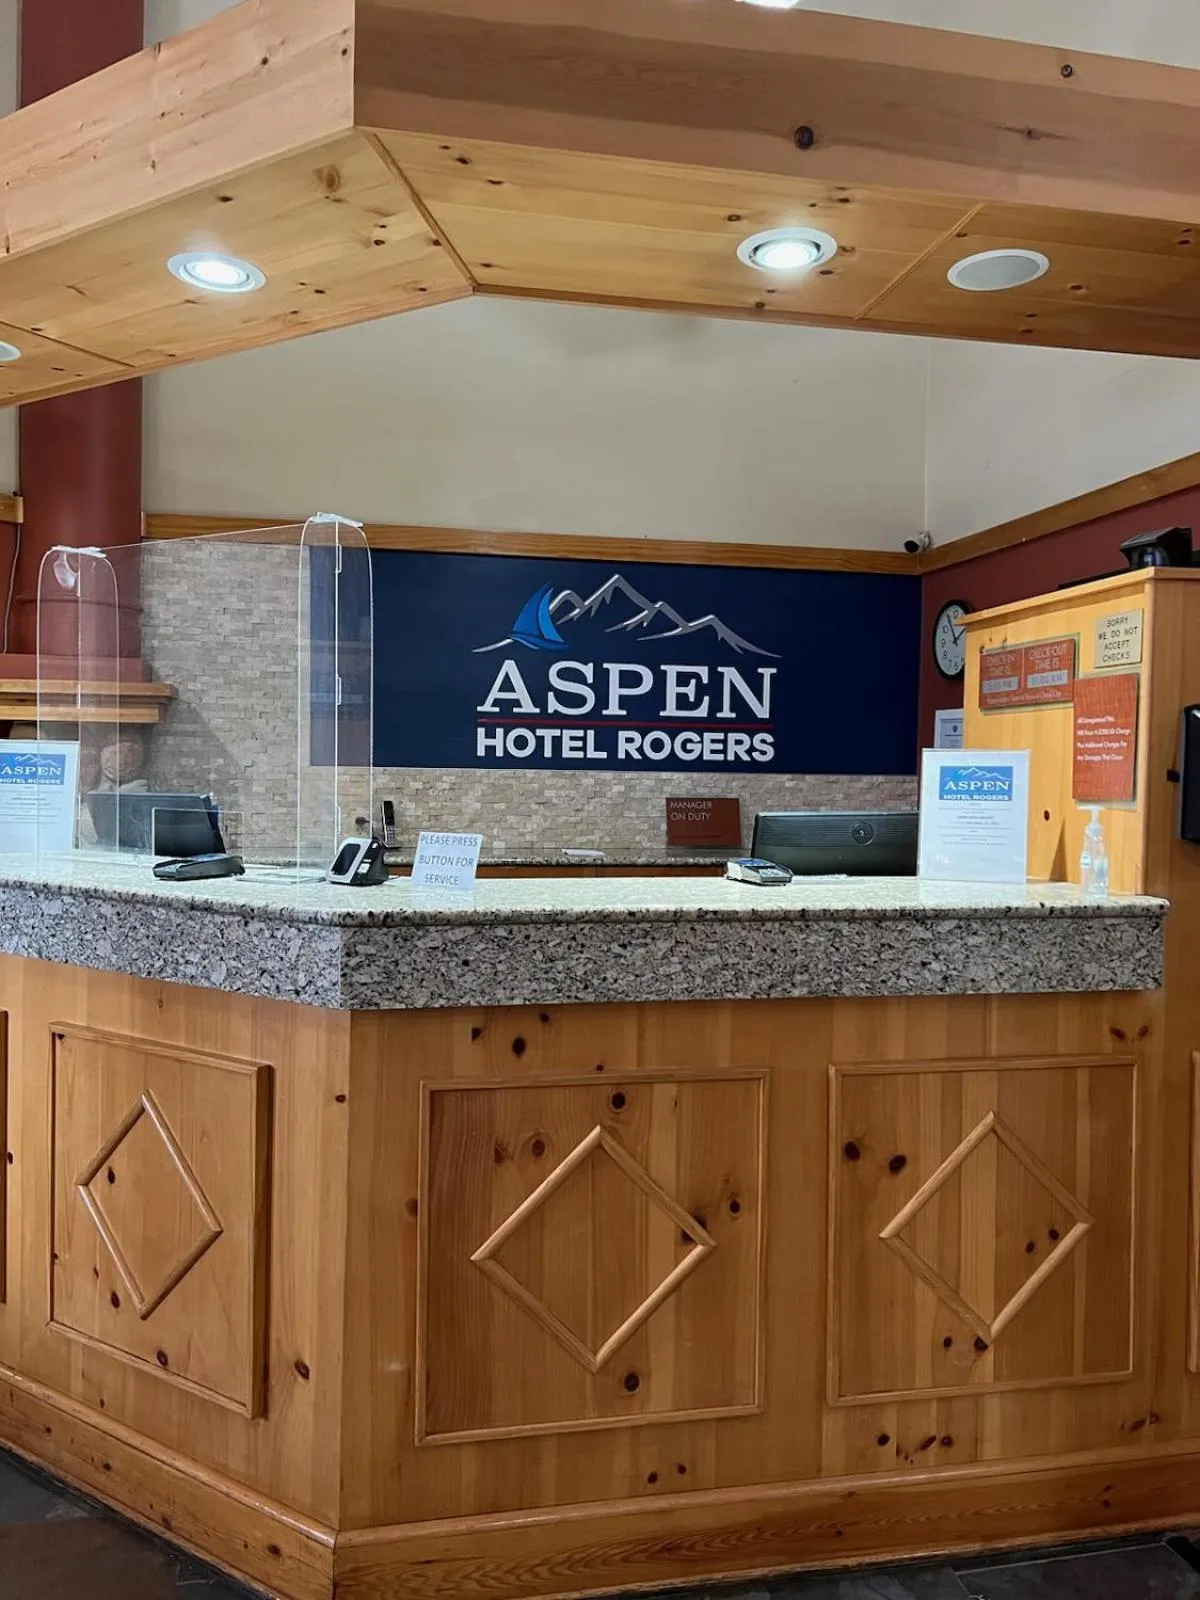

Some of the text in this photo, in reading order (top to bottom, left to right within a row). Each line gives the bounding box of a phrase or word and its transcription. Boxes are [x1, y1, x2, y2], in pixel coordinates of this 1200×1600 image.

[1107, 616, 1129, 628] SORRY
[1098, 626, 1138, 640] WE DO NOT
[1104, 640, 1130, 651] ACCEPT
[1103, 651, 1130, 663] CHECKS
[476, 659, 777, 719] ASPEN
[476, 727, 775, 762] HOTEL ROGERS
[0, 766, 62, 776] ASPEN
[944, 780, 1010, 791] ASPEN
[670, 801, 713, 809] MANAGER
[671, 812, 711, 821] ON DUTY
[420, 834, 478, 847] PLEASE PRESS
[418, 854, 474, 868] BUTTON FOR
[424, 873, 459, 886] SERVICE
